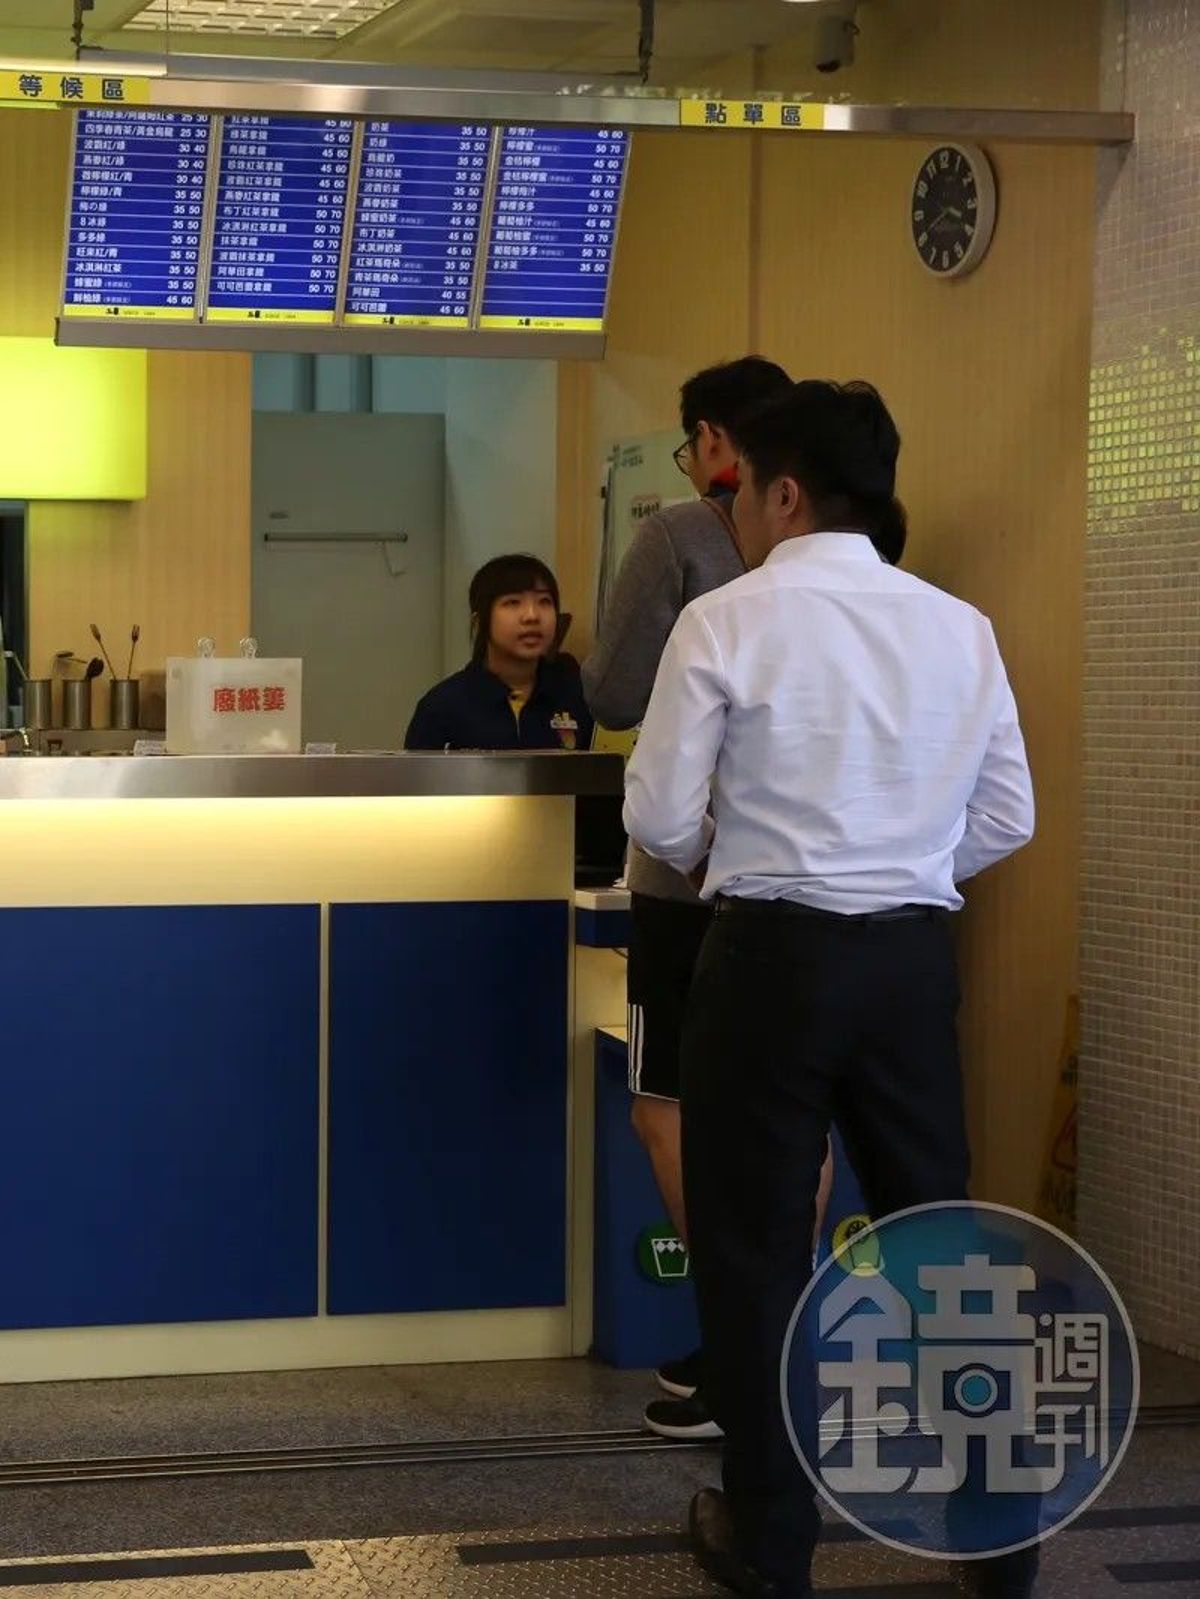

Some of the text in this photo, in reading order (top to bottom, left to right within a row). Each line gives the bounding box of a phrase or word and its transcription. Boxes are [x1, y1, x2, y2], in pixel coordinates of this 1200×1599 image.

[19, 74, 125, 100] 等候區
[705, 103, 802, 126] 點單區
[180, 128, 191, 137] 25
[196, 128, 206, 137] 30
[324, 133, 334, 142] 45
[338, 133, 350, 142] 60
[179, 143, 190, 152] 30
[194, 144, 205, 153] 40
[460, 142, 471, 150] 35
[474, 142, 485, 151] 50
[596, 144, 606, 153] 50
[610, 144, 622, 153] 70
[322, 148, 333, 157] 45
[337, 148, 348, 157] 60
[178, 158, 188, 167] 30
[193, 159, 204, 168] 40
[459, 156, 483, 166] 35 50
[594, 159, 604, 168] 45
[608, 159, 619, 168] 60
[321, 163, 331, 172] 45
[336, 164, 346, 172] 60
[177, 174, 203, 183] 30 40
[457, 171, 467, 180] 35
[470, 172, 481, 181] 50
[592, 174, 617, 183] 50 70
[319, 178, 330, 187] 45
[334, 179, 345, 188] 60
[175, 189, 186, 198] 35
[190, 189, 201, 198] 50
[455, 186, 465, 195] 35
[468, 187, 479, 196] 50
[590, 189, 615, 198] 45 60
[318, 193, 328, 202] 45
[332, 194, 344, 203] 60
[174, 204, 185, 213] 35
[189, 204, 200, 213] 50
[453, 201, 478, 210] 35 50
[588, 204, 598, 212] 50
[602, 204, 613, 213] 70
[316, 208, 327, 218] 50
[331, 209, 342, 218] 70
[173, 219, 183, 228] 35
[188, 220, 199, 229] 50
[451, 216, 476, 225] 45 60
[586, 218, 611, 228] 45 60
[315, 224, 325, 233] 50
[330, 224, 340, 233] 70
[172, 235, 182, 244] 35
[186, 235, 197, 244] 50
[449, 231, 460, 240] 45
[463, 231, 474, 240] 60
[584, 233, 609, 243] 50 70
[313, 239, 324, 248] 50
[328, 239, 339, 248] 70
[170, 250, 181, 259] 35
[185, 250, 196, 259] 50
[447, 246, 458, 255] 45
[461, 246, 472, 255] 60
[582, 248, 607, 257] 50 70
[312, 254, 338, 263] 50 70
[169, 265, 180, 274] 35
[184, 265, 195, 274] 50
[446, 261, 456, 270] 35
[459, 261, 470, 270] 50
[580, 263, 590, 272] 35
[594, 263, 605, 272] 50
[310, 269, 321, 278] 50
[325, 269, 336, 278] 70
[168, 280, 178, 289] 35
[182, 281, 193, 290] 50
[444, 276, 454, 285] 35
[457, 276, 468, 285] 50
[309, 284, 334, 293] 50 70
[442, 291, 452, 300] 40
[455, 291, 466, 300] 55
[166, 296, 192, 305] 45 60
[440, 306, 464, 315] 45 60
[213, 686, 286, 712] 廢紙簍
